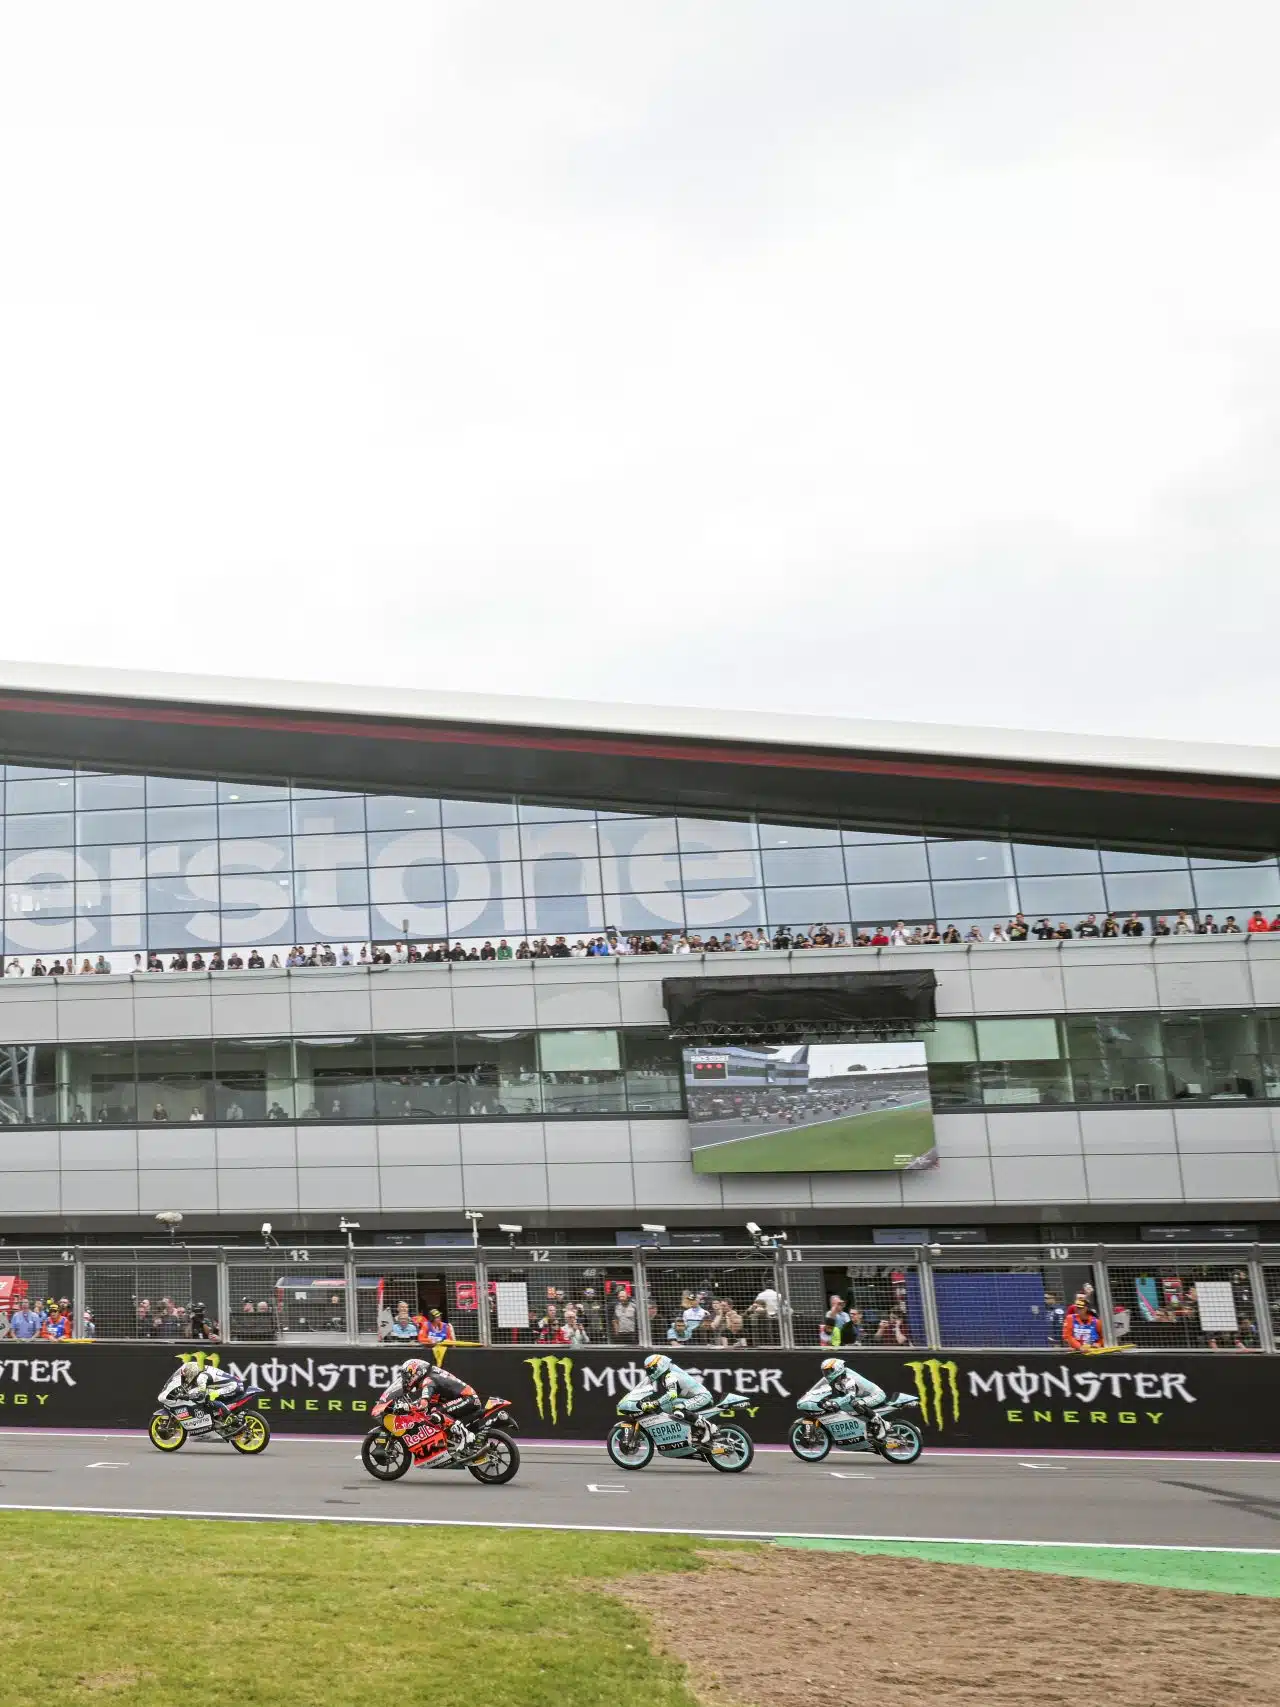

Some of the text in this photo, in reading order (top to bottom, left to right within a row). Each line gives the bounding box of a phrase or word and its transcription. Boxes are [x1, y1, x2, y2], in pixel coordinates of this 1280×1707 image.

[291, 1250, 309, 1261] 13
[530, 1250, 550, 1261] 12
[966, 1366, 1197, 1403] MONSTER
[258, 1398, 368, 1411] ENERG
[1007, 1409, 1165, 1425] ENERGY
